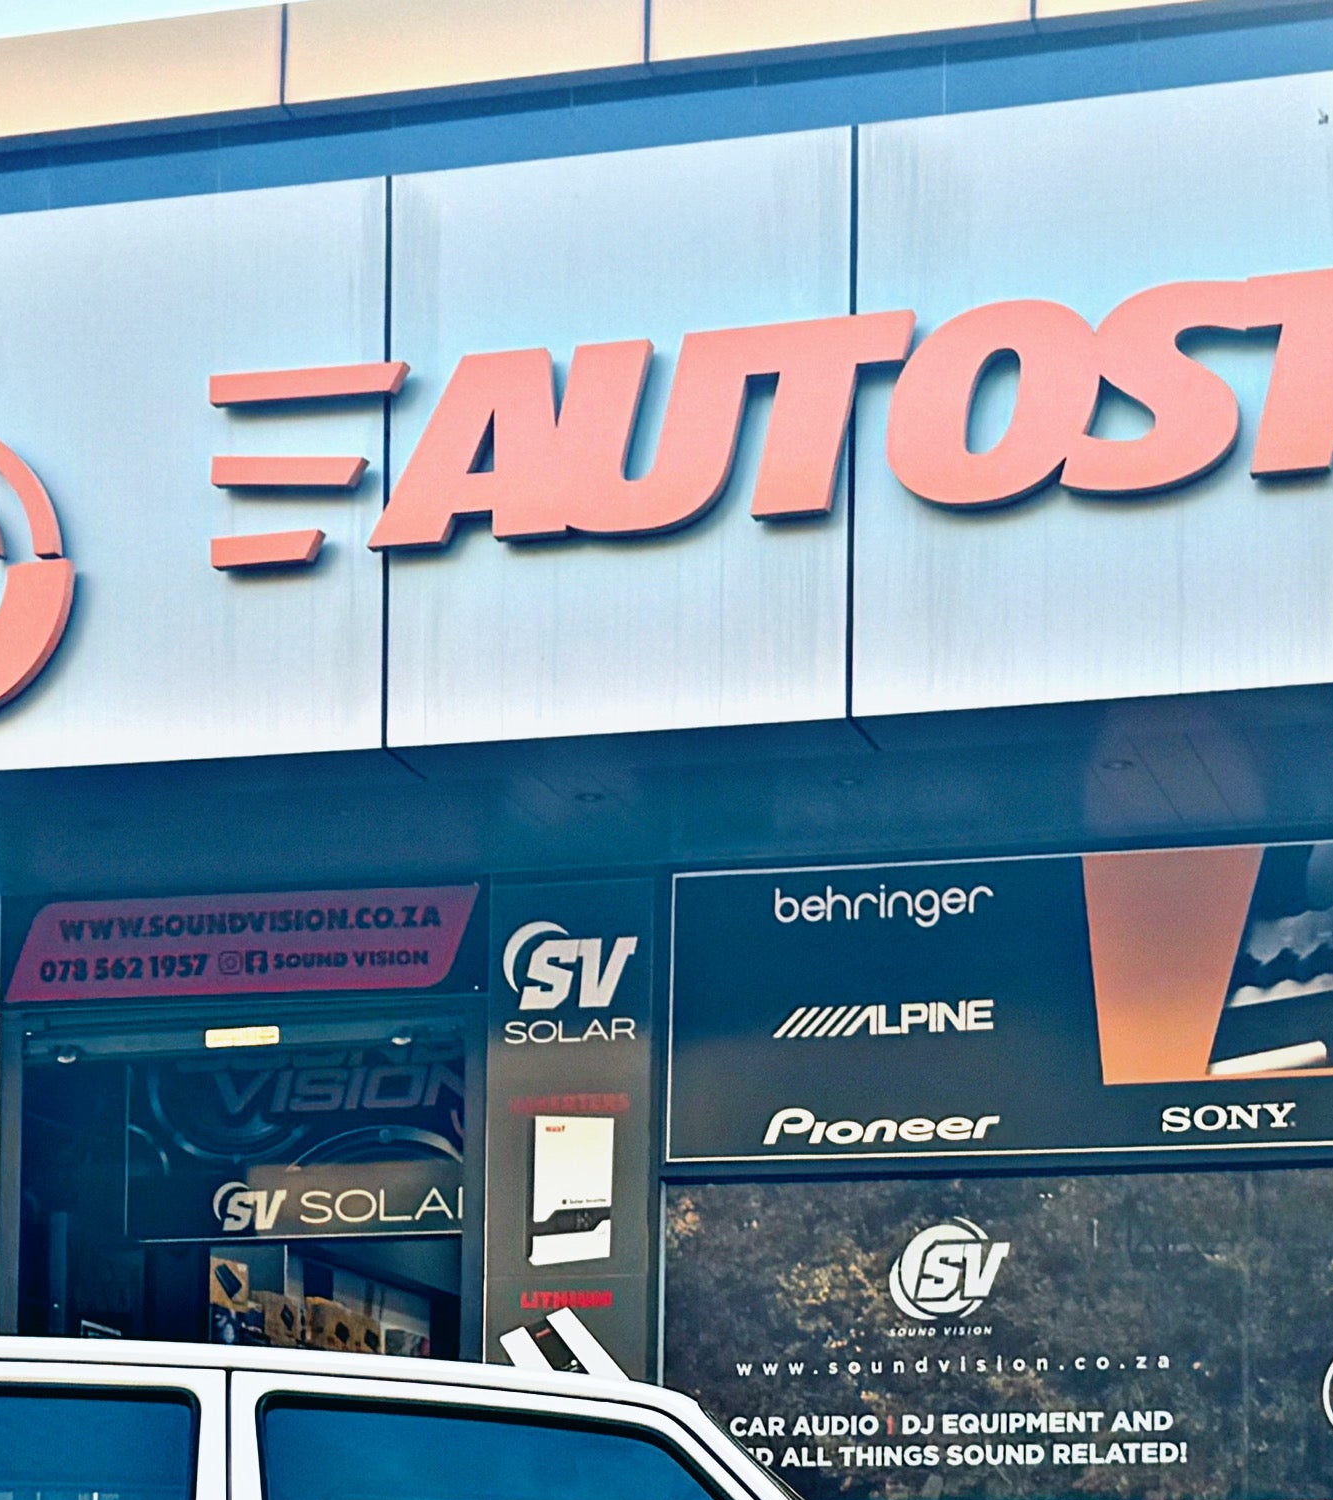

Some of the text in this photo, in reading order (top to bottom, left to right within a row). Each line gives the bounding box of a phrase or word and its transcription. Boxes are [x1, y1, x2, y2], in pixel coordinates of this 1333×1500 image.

[774, 884, 995, 928] behringer
[60, 906, 442, 942] WWW.SOUNDVISION.CO.ZA
[40, 949, 430, 983] 078 562 1957 SOUND VISION
[519, 936, 639, 1010] SV
[504, 1017, 636, 1045] SOLAR
[841, 999, 995, 1037] ALPINE
[762, 1107, 1001, 1145] Pioneer
[1161, 1102, 1296, 1132] SONY
[222, 1186, 464, 1232] SV SOLA
[889, 1326, 993, 1338] SOUND VISION
[736, 1352, 1170, 1377] www.soundvision.co.za
[729, 1410, 1174, 1438] CAR AUDIO DJ EQUIPMENT AND
[780, 1446, 833, 1468] ALL
[838, 1445, 940, 1467] THINGS
[946, 1443, 1045, 1467] SOUND
[1053, 1441, 1188, 1465] RELATED!
